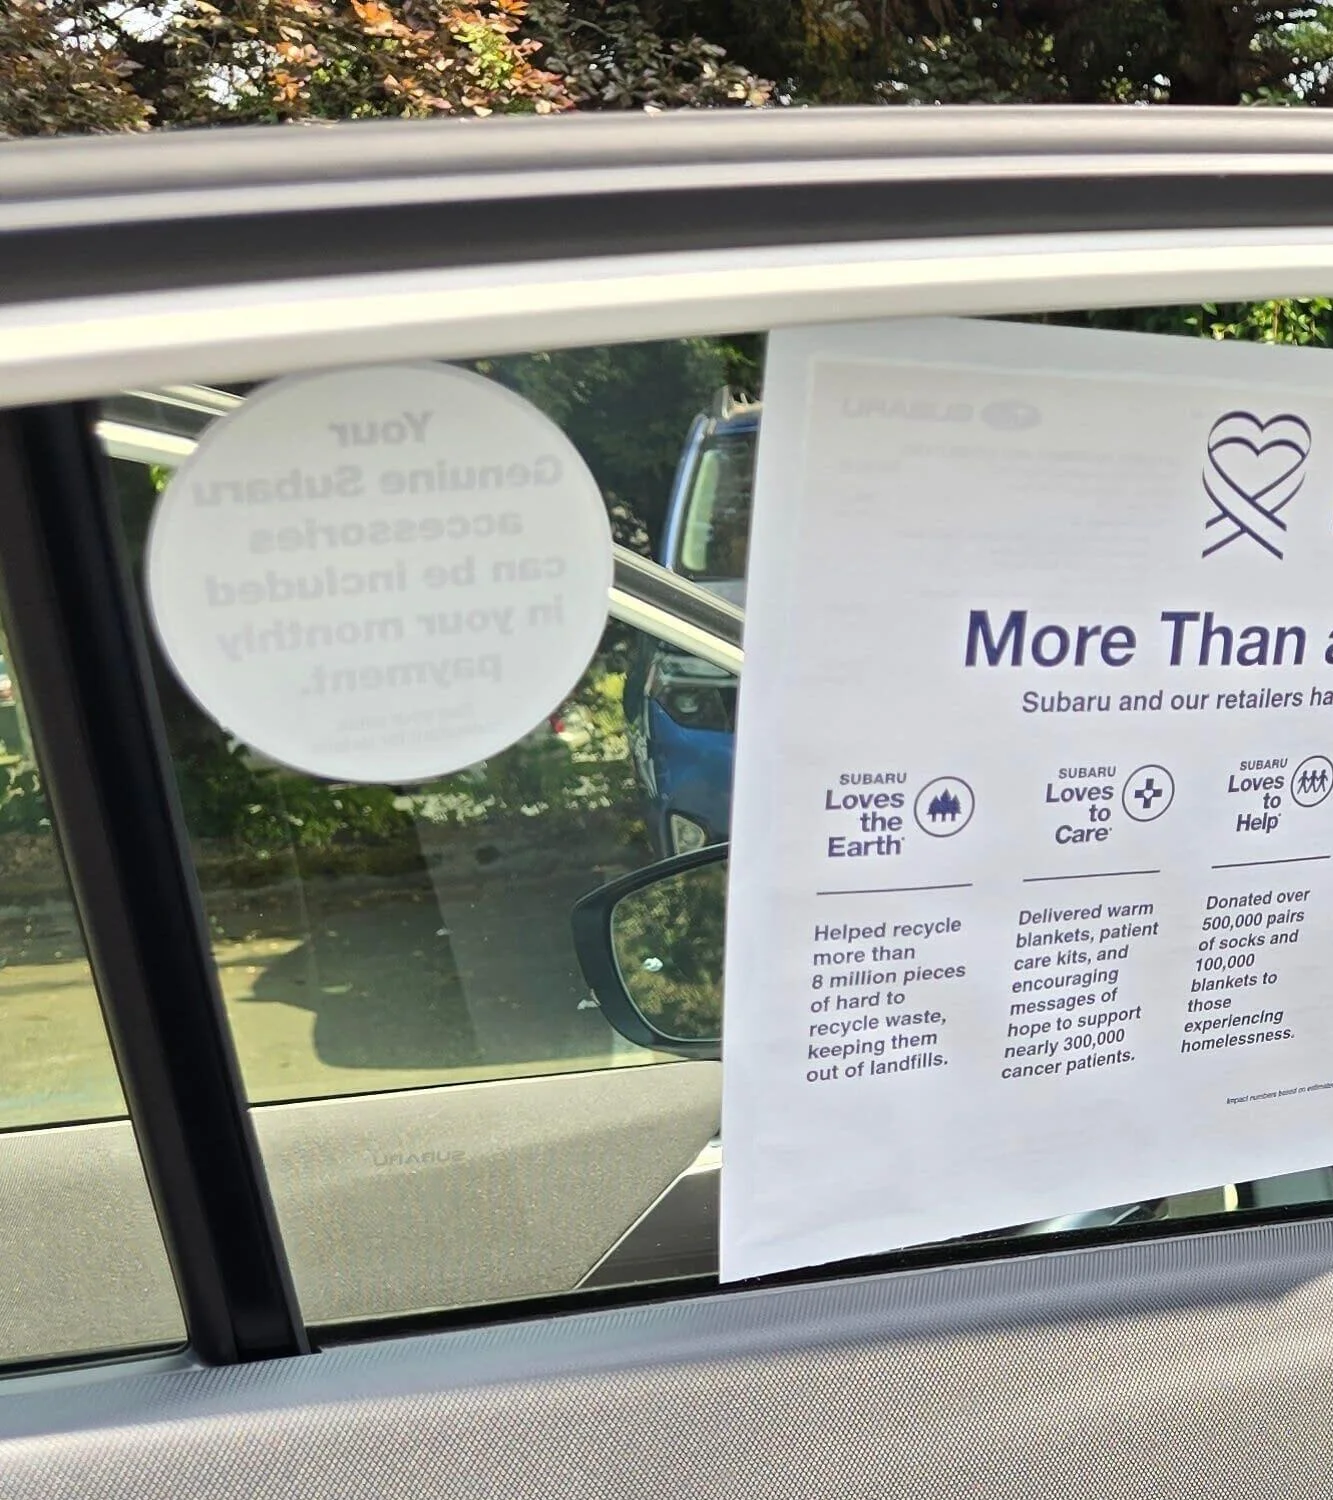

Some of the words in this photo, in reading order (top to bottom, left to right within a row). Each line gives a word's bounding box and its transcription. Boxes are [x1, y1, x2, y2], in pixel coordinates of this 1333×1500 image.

[965, 610, 1136, 667] More
[1160, 611, 1306, 666] Than
[1022, 691, 1111, 713] Subaru
[1119, 690, 1163, 711] and
[1171, 694, 1210, 710] our
[1216, 688, 1303, 709] retailers
[1058, 766, 1116, 779] SUBARU
[1240, 758, 1288, 771] SUBARU
[839, 772, 907, 786] SUBARU
[1228, 775, 1285, 793] Loves
[825, 790, 904, 810] Loves
[1046, 783, 1114, 803] Loves
[1263, 792, 1281, 810] to
[860, 811, 903, 832] the
[1089, 804, 1111, 822] to
[1206, 890, 1273, 910] Donated
[1276, 890, 1310, 904] over
[1019, 904, 1102, 926] Delivered
[1107, 904, 1154, 918] warm
[1202, 912, 1263, 931] 500,000
[1266, 909, 1305, 929] pairs
[814, 922, 886, 944] Helped
[893, 917, 961, 939] recycle
[1016, 928, 1094, 948] blankets,
[1099, 922, 1159, 943] patient
[1198, 936, 1216, 951] of
[1219, 933, 1265, 950] socks
[1269, 929, 1299, 945] and
[813, 950, 865, 966] more
[871, 946, 915, 962] than
[1014, 956, 1051, 971] care
[1057, 950, 1091, 966] kits,
[1096, 944, 1129, 961] and
[1196, 953, 1255, 972] 100,000
[812, 974, 823, 990] 8
[830, 970, 897, 988] million
[903, 966, 966, 986] pieces
[1012, 968, 1119, 993] encouraging
[1191, 974, 1258, 992] blankets
[1263, 972, 1277, 984] to
[810, 996, 831, 1013] of
[836, 991, 880, 1010] hard
[886, 991, 905, 1005] to
[1010, 993, 1096, 1016] messages
[1101, 987, 1118, 1003] of
[1188, 998, 1231, 1012] those
[810, 1015, 879, 1037] recycle
[885, 1010, 946, 1027] waste,
[1007, 1022, 1051, 1038] hope
[1056, 1016, 1073, 1033] to
[1077, 1006, 1141, 1028] support
[1184, 1010, 1284, 1034] experiencing
[808, 1039, 885, 1060] keeping
[891, 1033, 937, 1050] them
[1004, 1035, 1059, 1058] nearly
[1063, 1027, 1125, 1051] 300,000
[1181, 1029, 1294, 1053] homelessness.
[806, 1065, 839, 1082] out
[843, 1058, 865, 1078] of
[870, 1052, 948, 1075] landfills.
[1001, 1062, 1062, 1080] cancer
[1066, 1050, 1135, 1075] patients.
